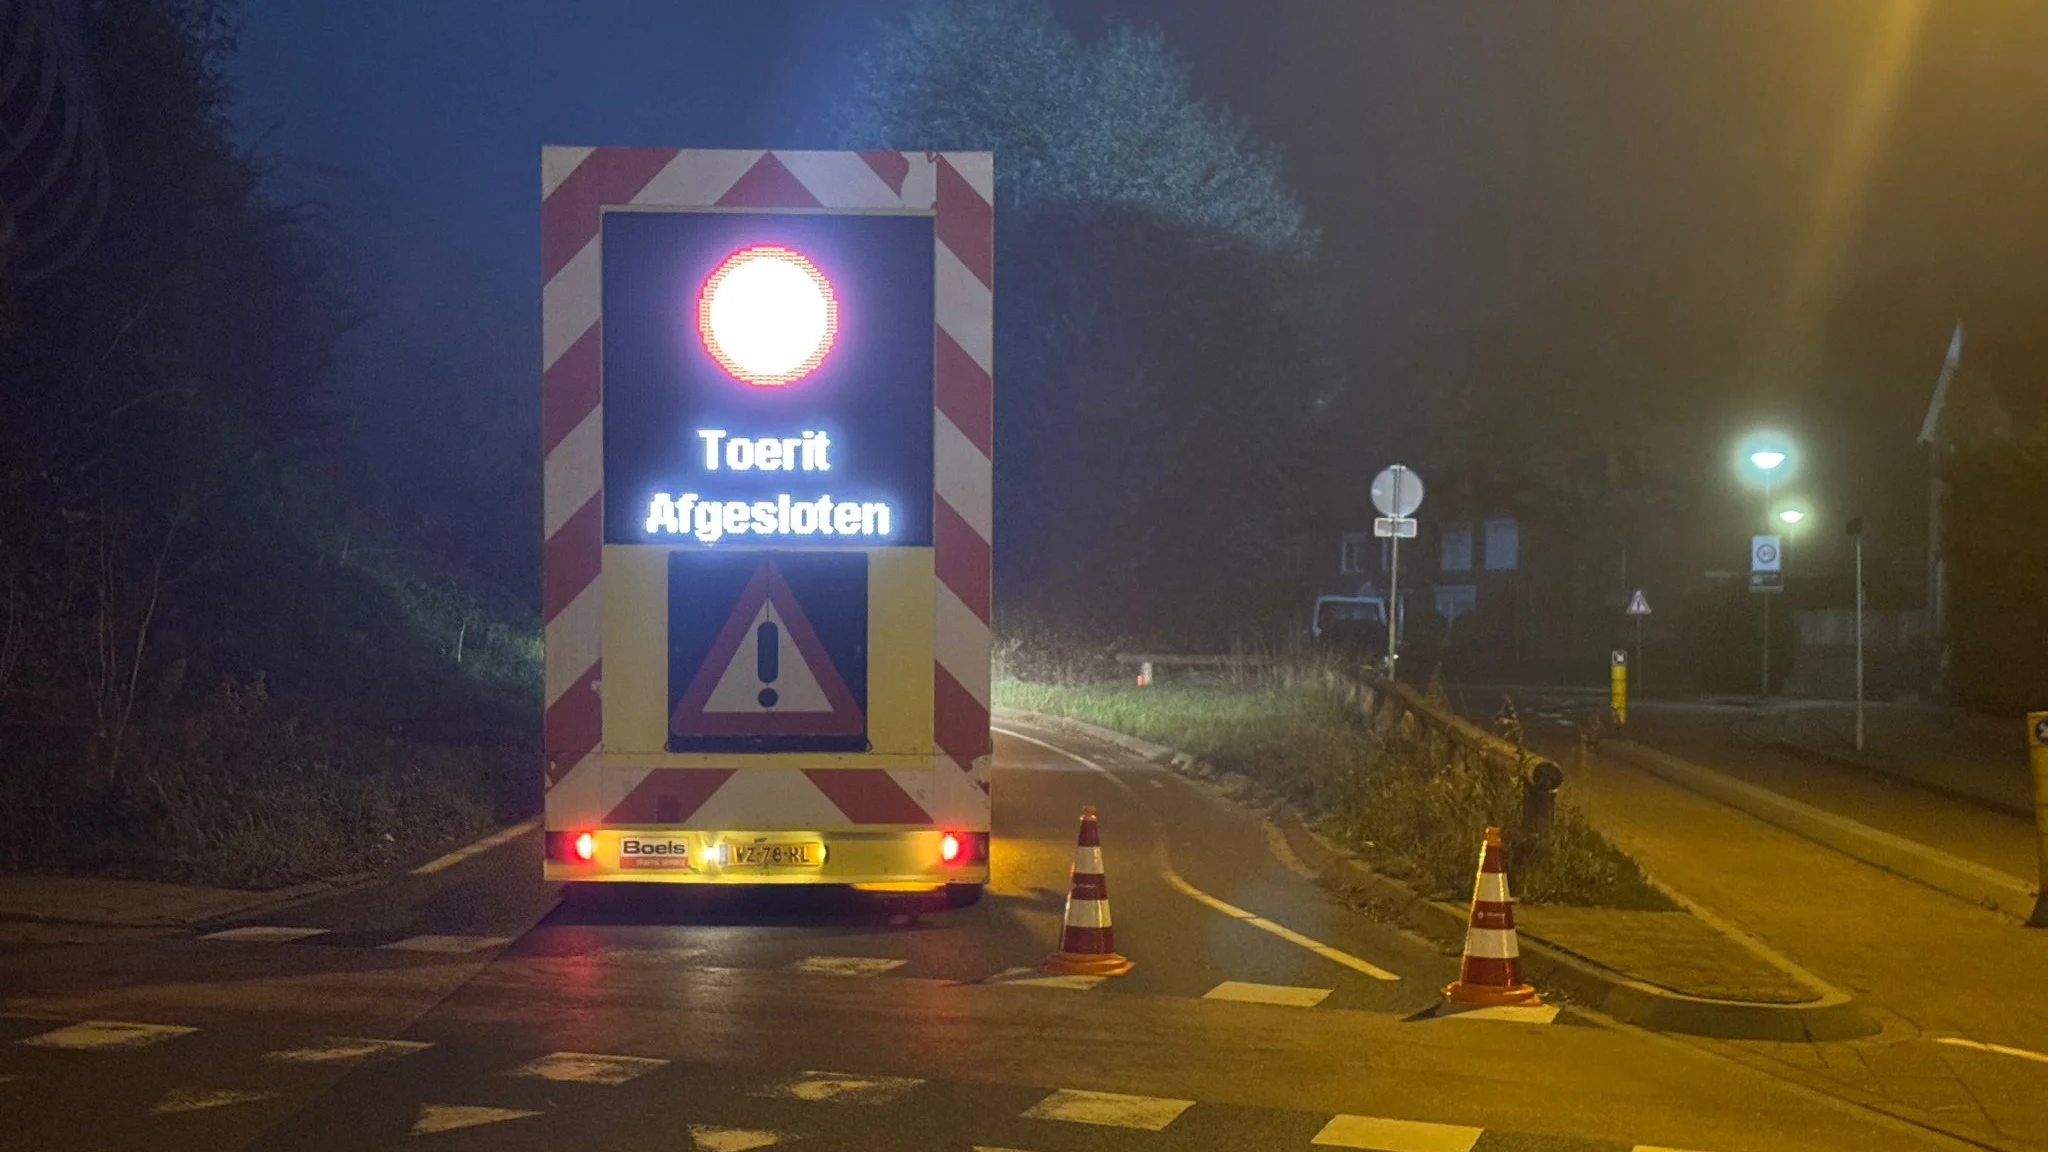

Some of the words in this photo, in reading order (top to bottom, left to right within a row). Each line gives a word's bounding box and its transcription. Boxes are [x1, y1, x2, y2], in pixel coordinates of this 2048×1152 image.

[698, 429, 831, 471] Toerit
[646, 493, 890, 541] Afgesloten
[623, 840, 686, 855] Boels
